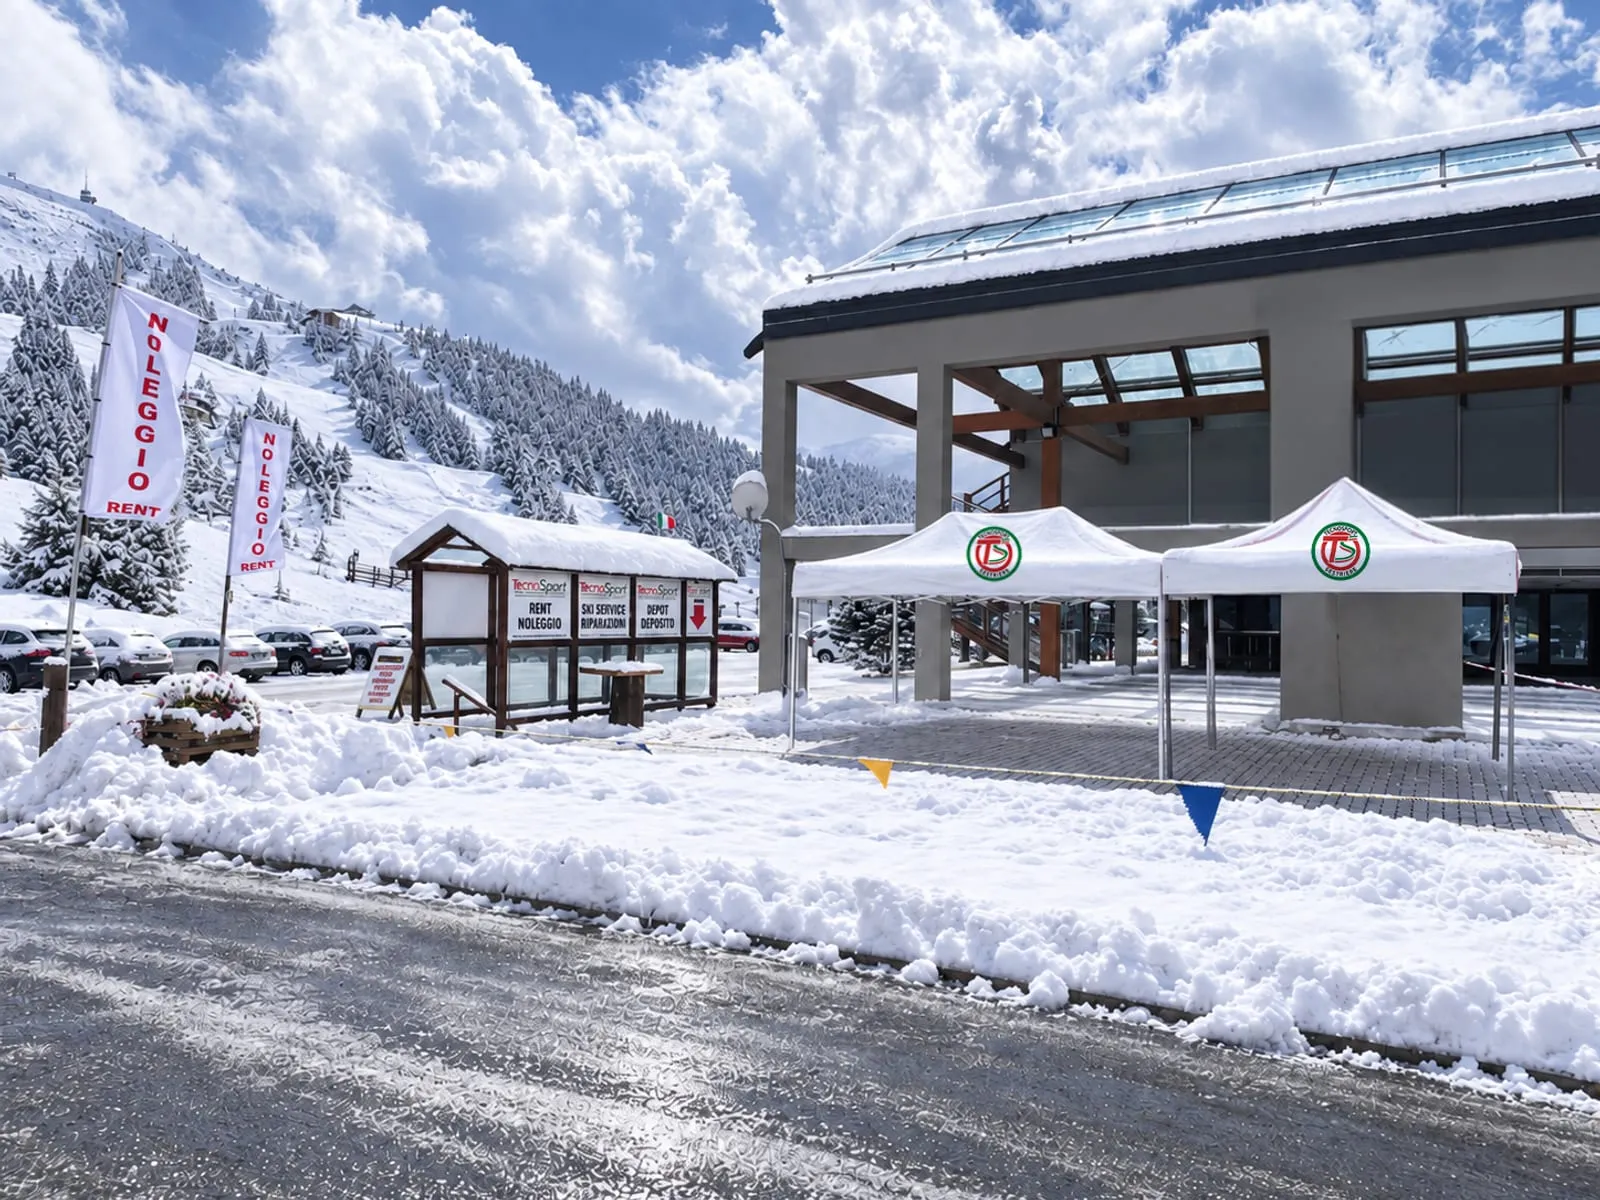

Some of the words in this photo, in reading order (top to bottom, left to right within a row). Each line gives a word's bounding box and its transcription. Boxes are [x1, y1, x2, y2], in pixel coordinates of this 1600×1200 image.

[107, 501, 161, 517] RENT
[240, 560, 276, 572] RENT
[512, 578, 567, 595] TecnoSport
[529, 602, 552, 615] RENT
[581, 603, 594, 615] SKI
[596, 603, 627, 616] SERVICE
[647, 604, 669, 616] DEPOT
[518, 616, 562, 630] NOLEGGIO
[580, 617, 627, 629] RIPARAZIONI
[641, 617, 675, 629] DEPOSITO
